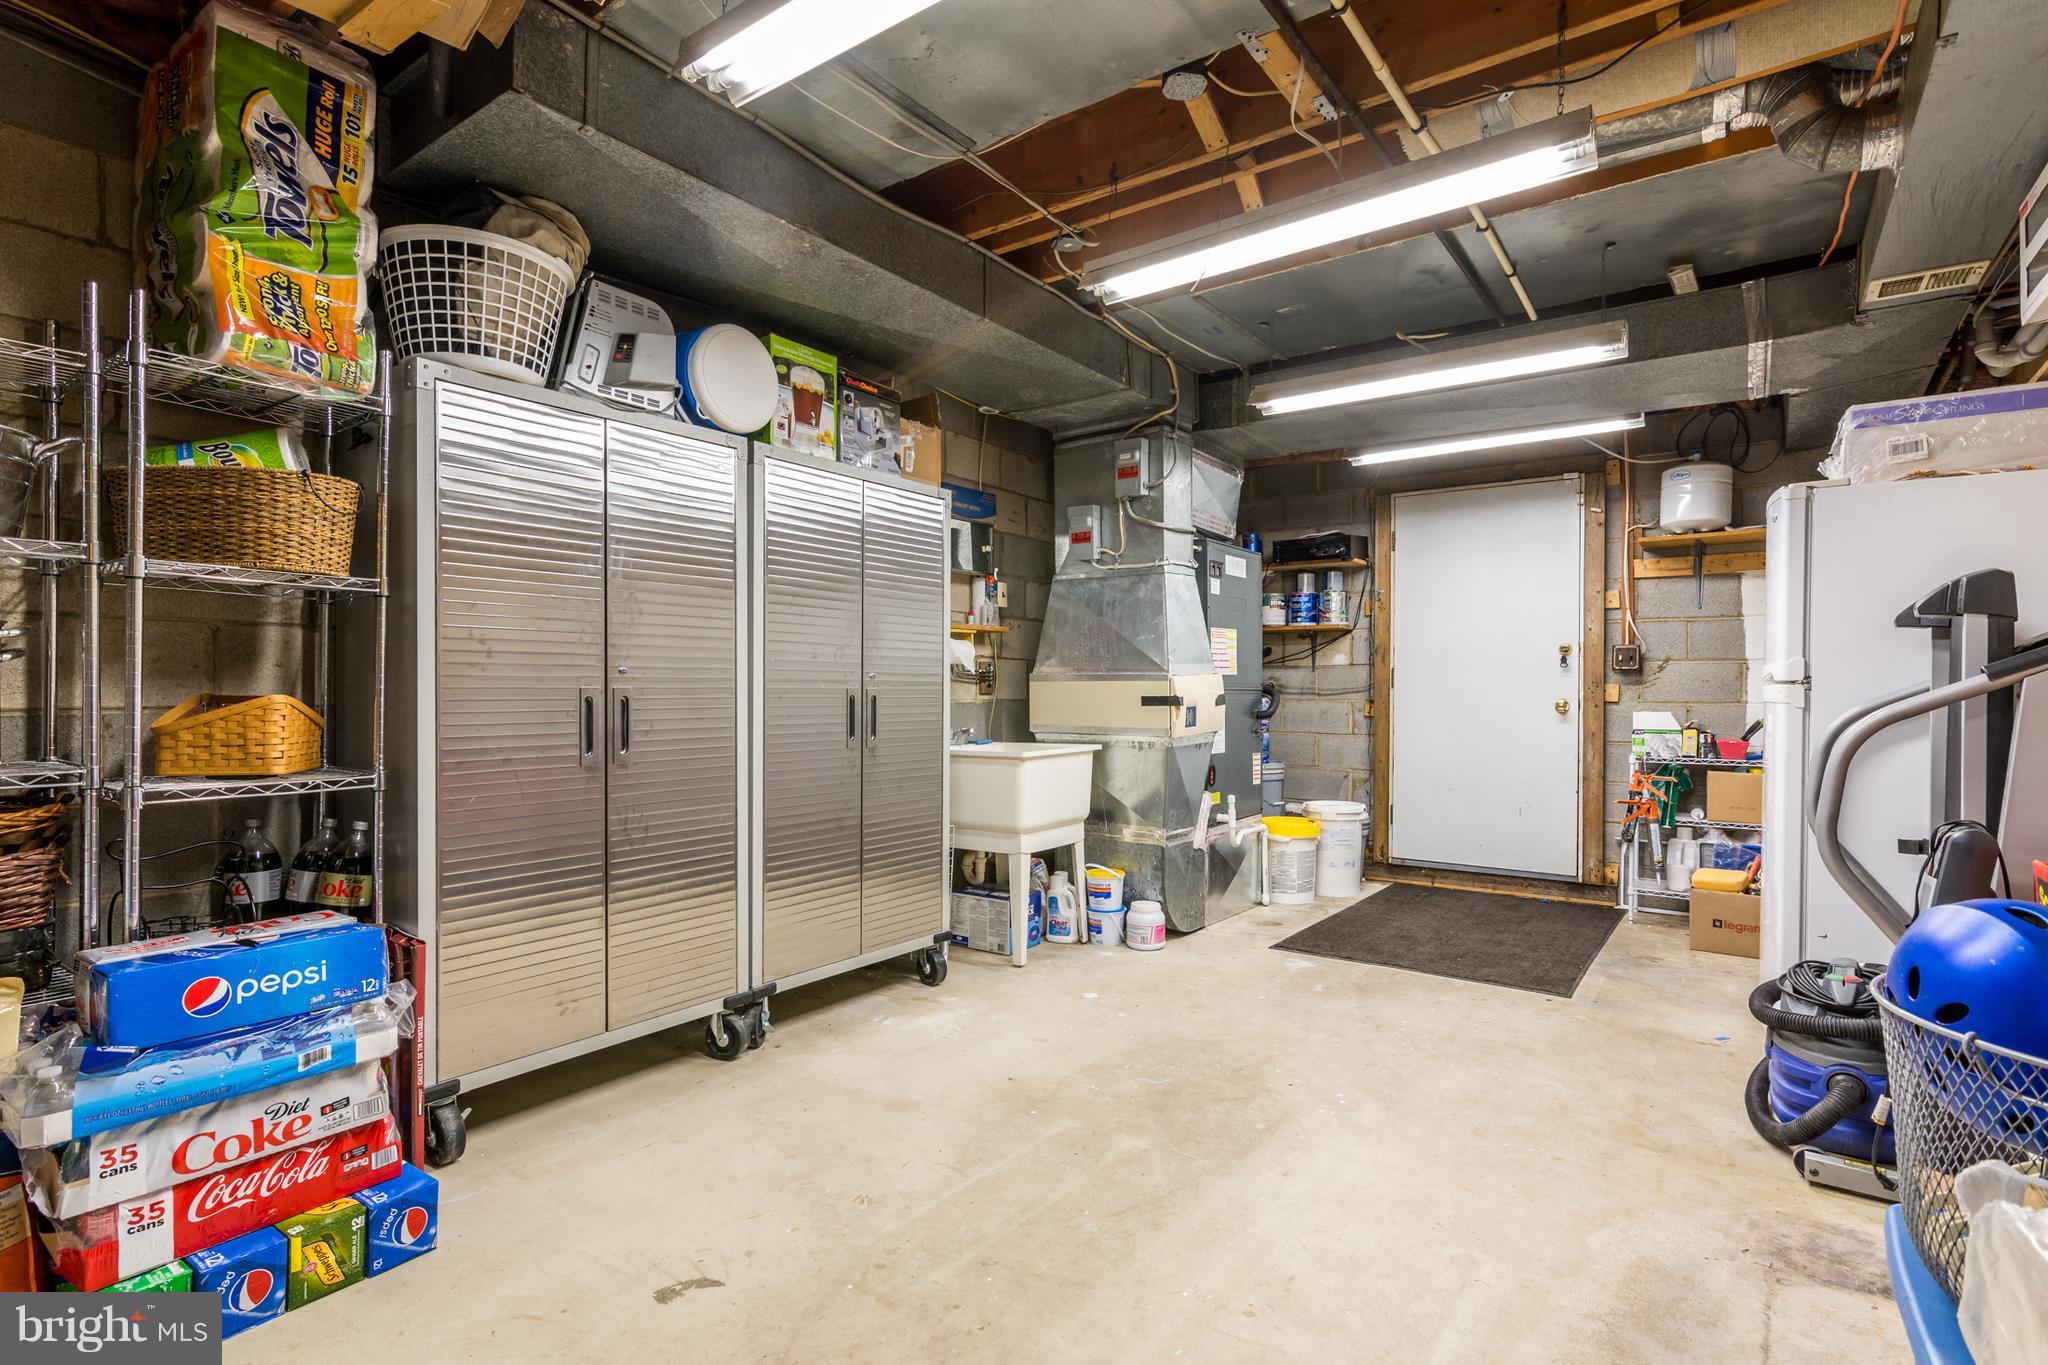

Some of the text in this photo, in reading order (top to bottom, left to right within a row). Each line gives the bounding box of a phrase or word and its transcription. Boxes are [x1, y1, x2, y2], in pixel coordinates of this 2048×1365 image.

[314, 80, 337, 160] HUGE Roll
[345, 111, 361, 139] 101
[343, 142, 360, 167] HUGE ROLLS
[254, 111, 314, 252] Towels
[341, 165, 358, 186] 15
[315, 279, 330, 296] Ft!
[239, 296, 248, 314] NEW!
[272, 287, 299, 334] Thick
[1724, 919, 1760, 934] legran
[236, 959, 328, 1005] pepsi
[361, 978, 375, 993] 12
[264, 1097, 312, 1122] Diet
[100, 1143, 138, 1170] 35
[171, 1114, 312, 1175] Coke
[99, 1162, 138, 1180] cans
[187, 1137, 334, 1223] Coca-Cola
[128, 1200, 165, 1226] 35
[379, 1208, 398, 1239] pepsi
[127, 1218, 164, 1236] cans
[311, 1245, 339, 1282] Schweppes
[216, 1271, 235, 1295] pep
